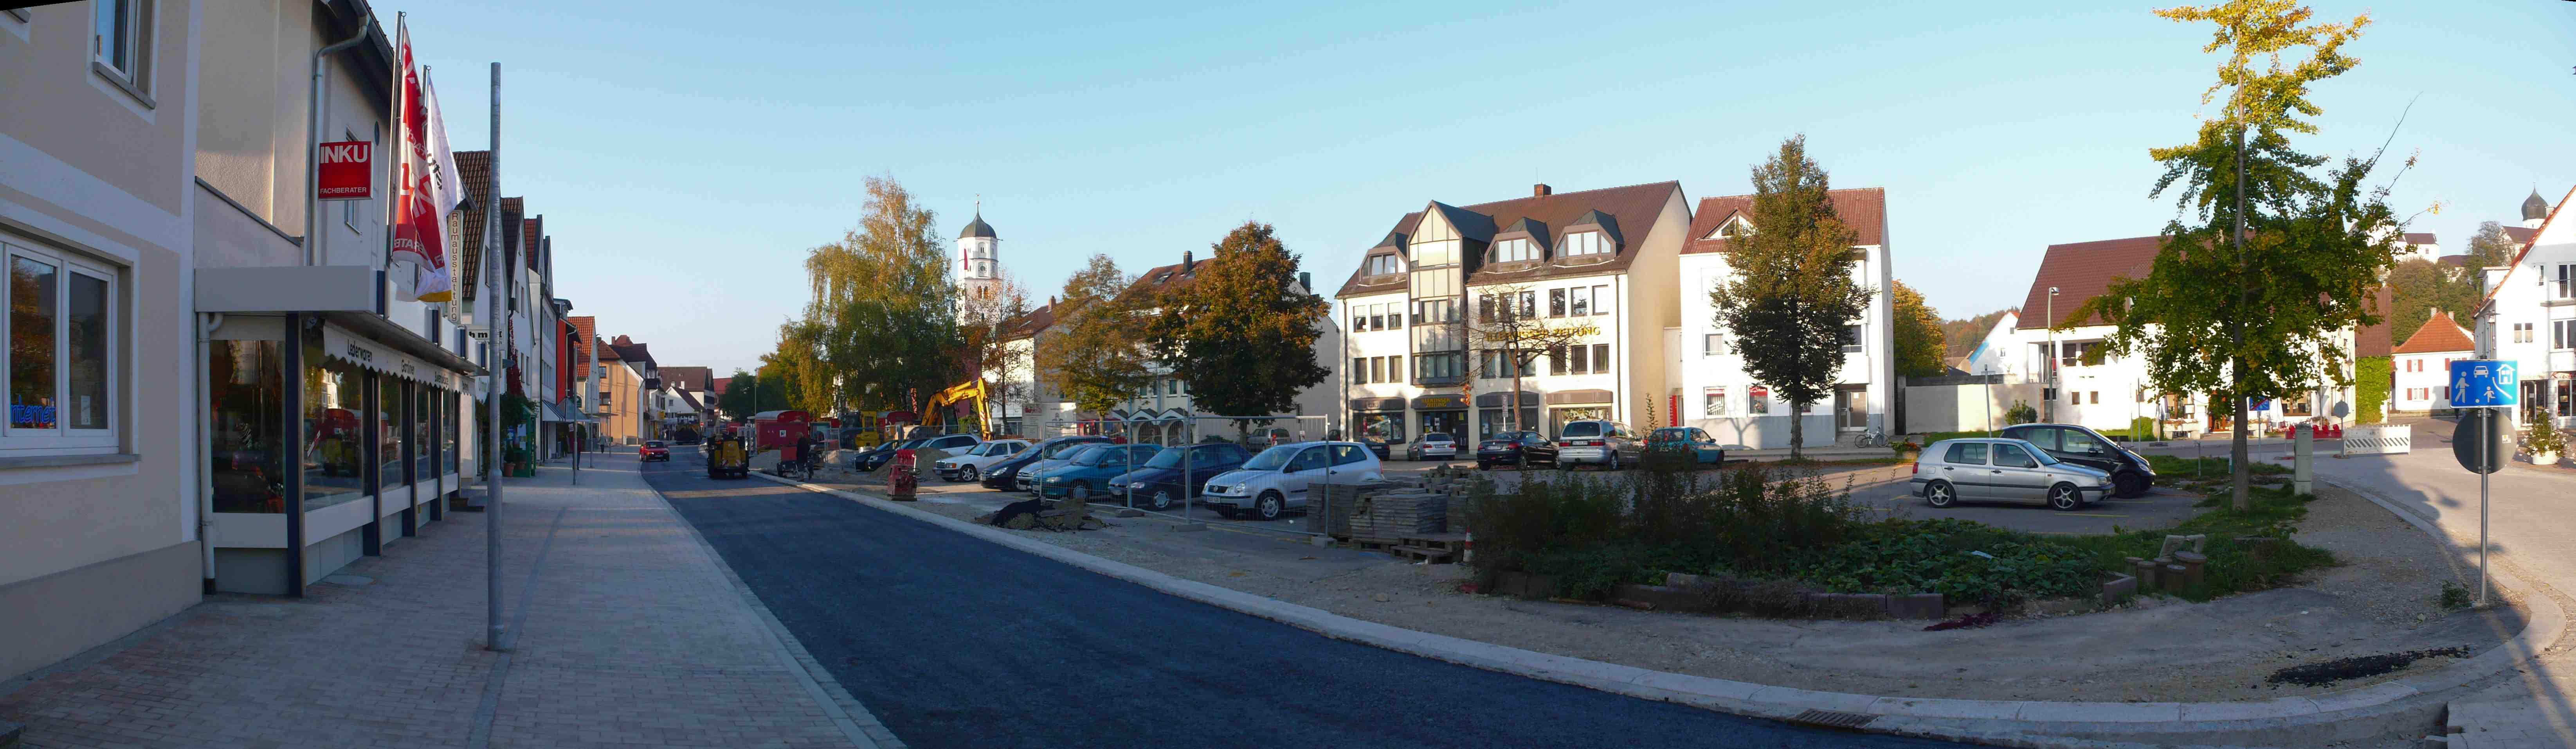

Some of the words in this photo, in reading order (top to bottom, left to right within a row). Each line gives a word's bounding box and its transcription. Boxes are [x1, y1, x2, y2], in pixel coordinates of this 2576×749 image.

[320, 145, 368, 163] INKU
[450, 212, 459, 321] Raumausstattung
[348, 339, 372, 363] Lederwaren
